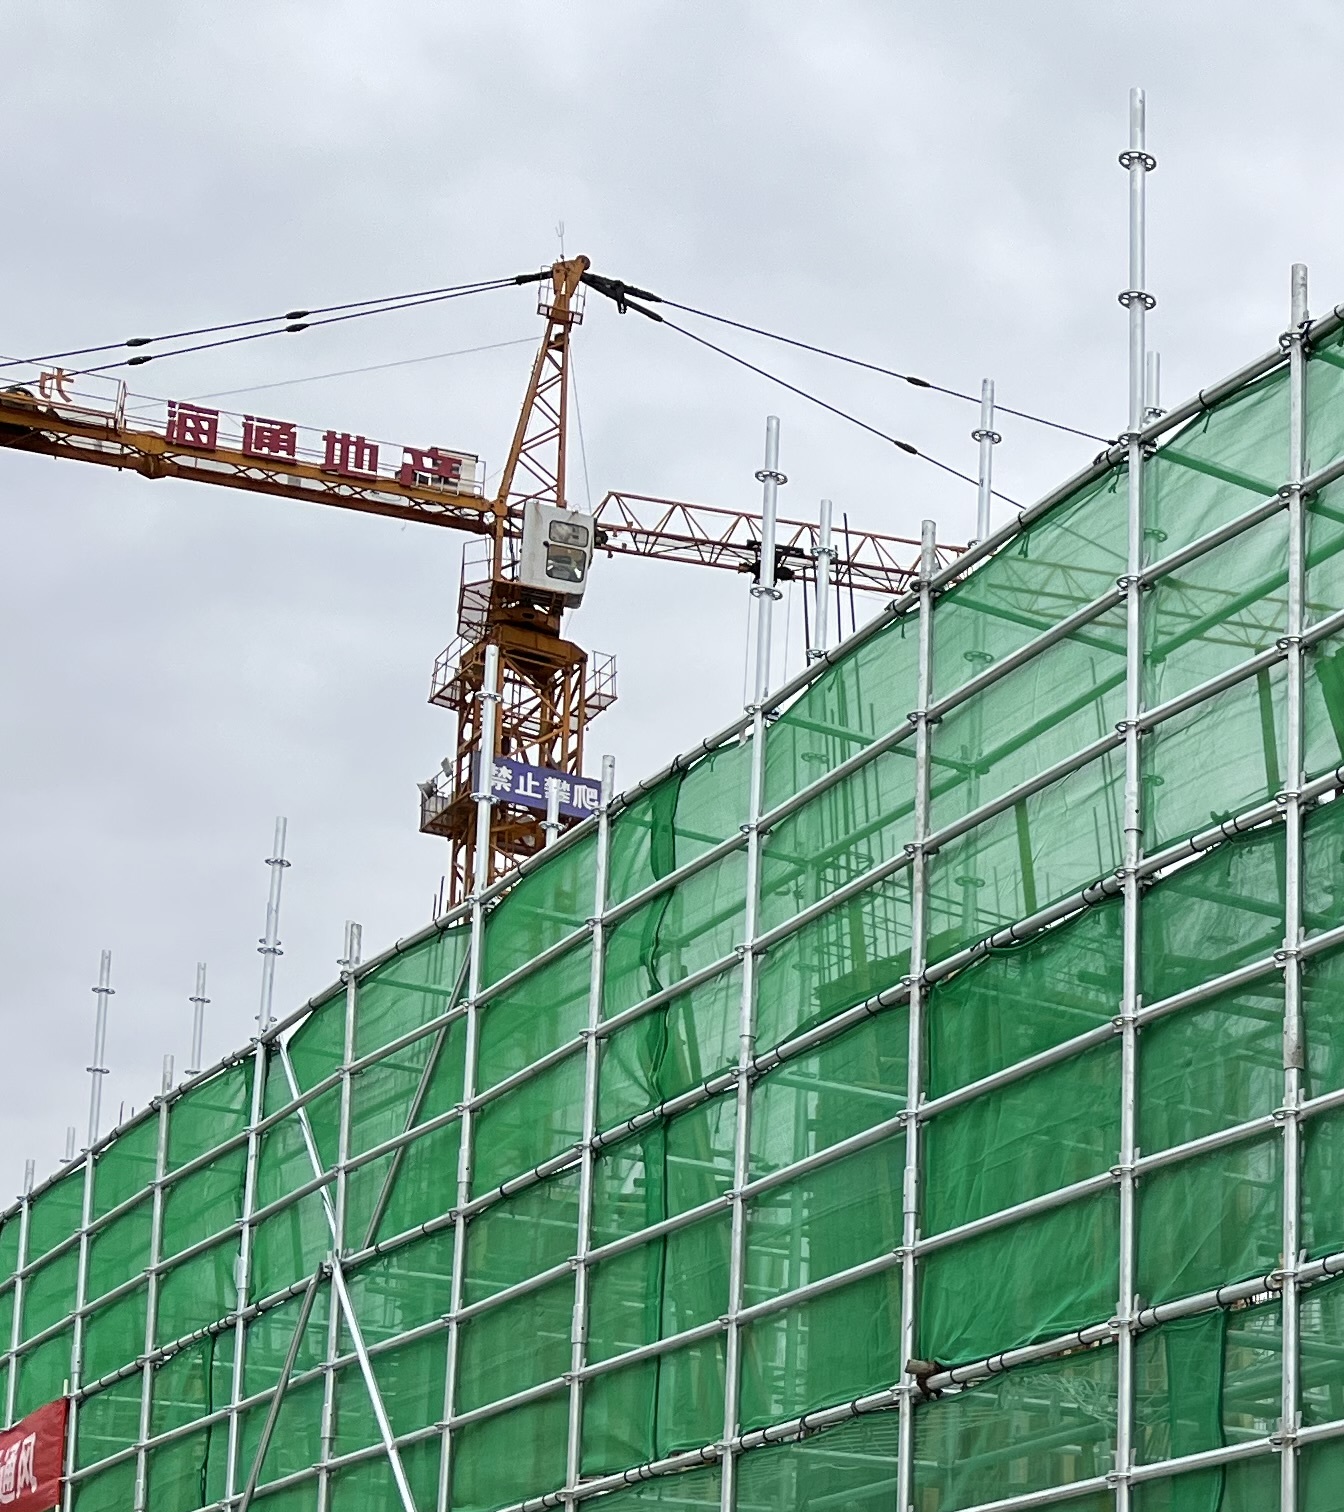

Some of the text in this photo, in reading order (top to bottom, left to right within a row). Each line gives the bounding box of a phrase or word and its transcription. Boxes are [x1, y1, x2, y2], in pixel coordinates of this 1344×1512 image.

[166, 400, 462, 487] 海通地产
[491, 762, 599, 810] 禁止攀爬
